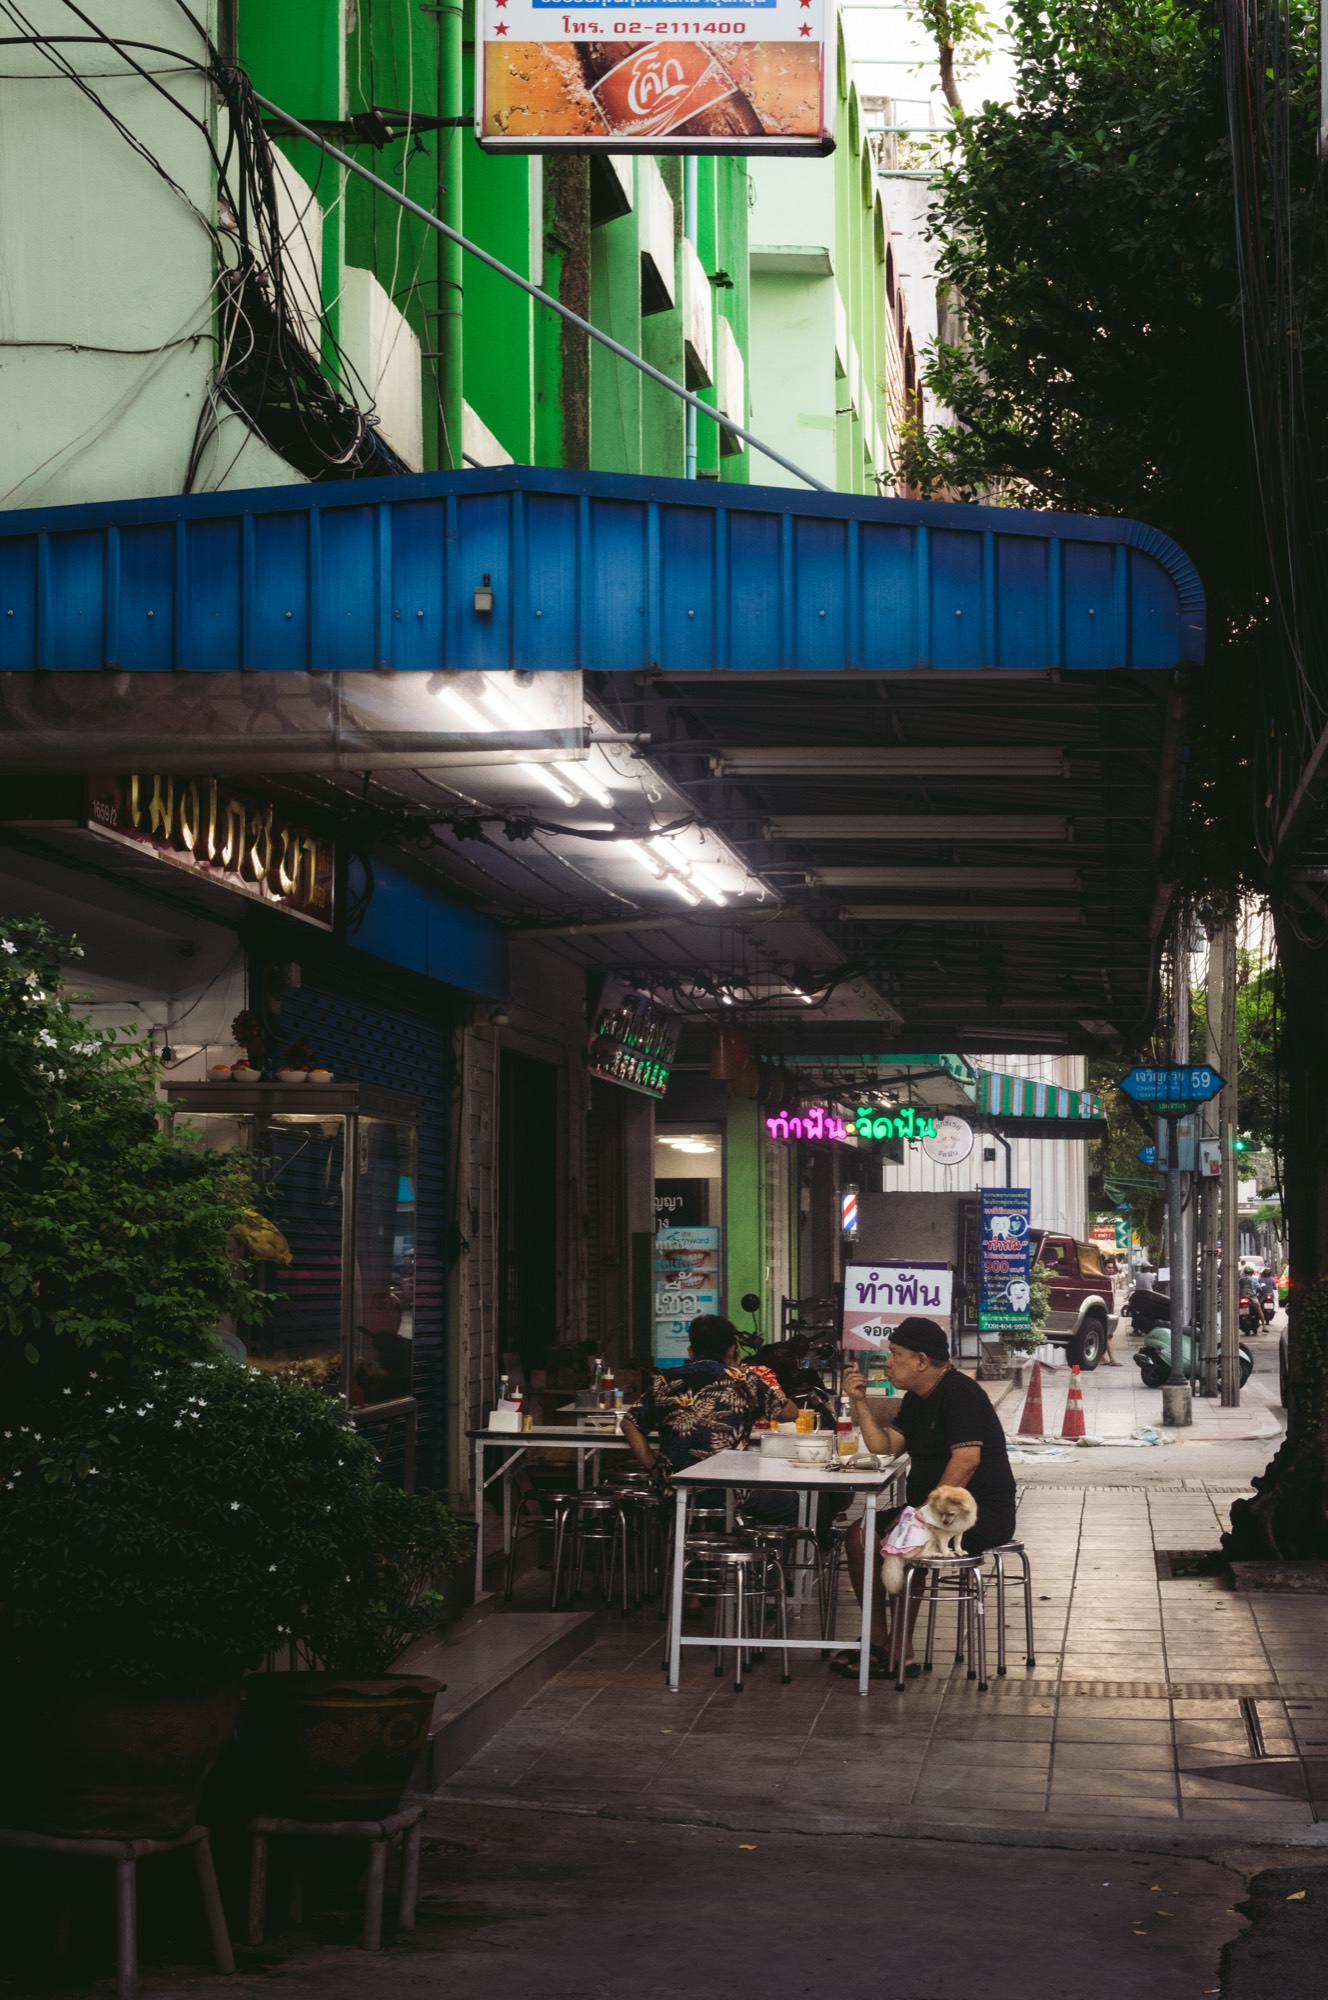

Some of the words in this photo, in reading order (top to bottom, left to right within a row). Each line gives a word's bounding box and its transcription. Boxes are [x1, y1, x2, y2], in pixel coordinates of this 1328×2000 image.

[562, 15, 604, 34] โทร.
[613, 21, 746, 34] 02-2111400
[1191, 1071, 1211, 1088] 59
[766, 1108, 847, 1140] ทำฟัน
[984, 1260, 1009, 1273] 900
[856, 1272, 941, 1307] ทำฟัน
[863, 1325, 898, 1337] จอด
